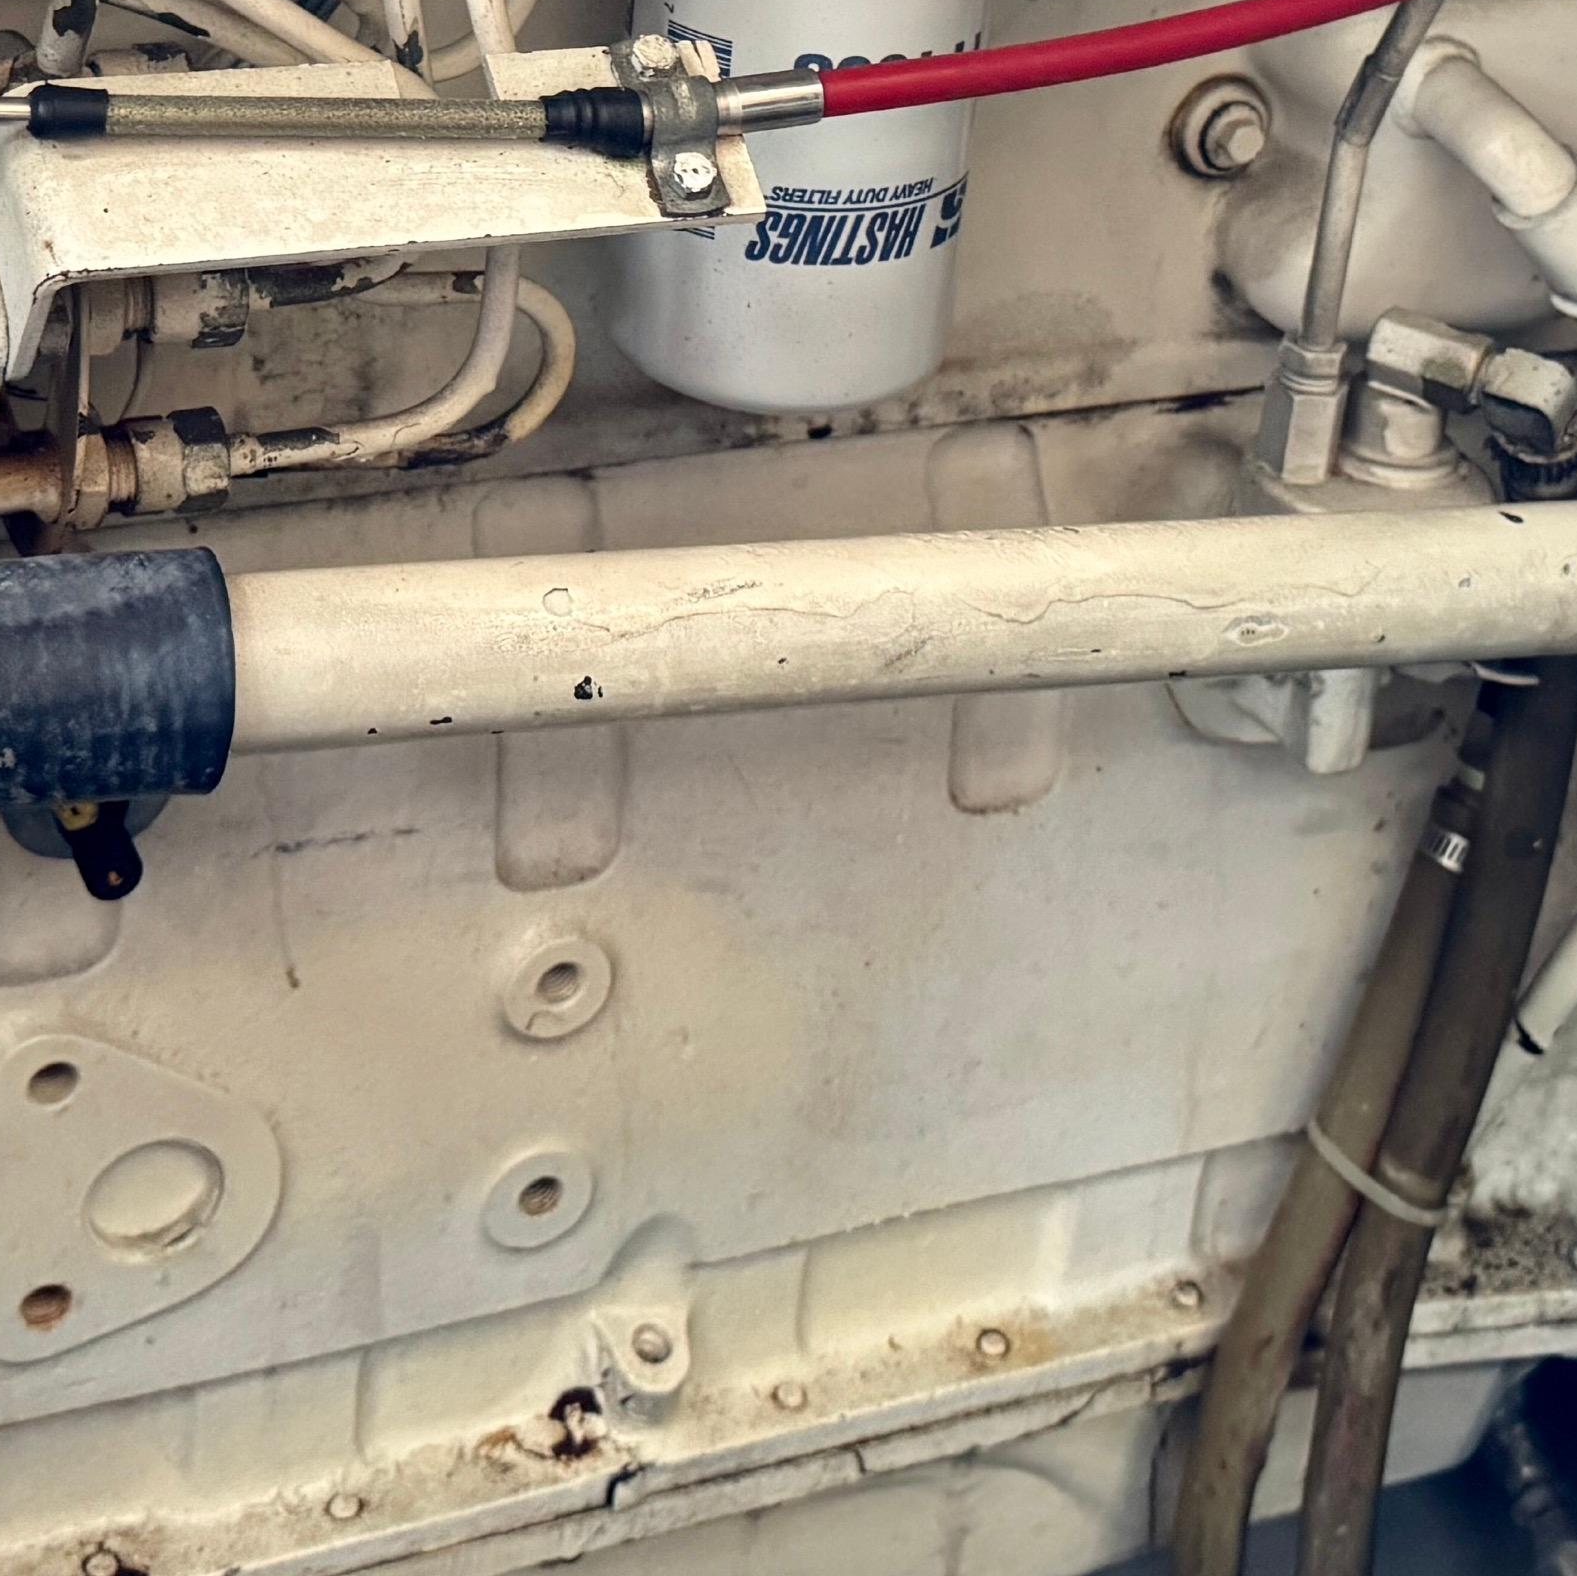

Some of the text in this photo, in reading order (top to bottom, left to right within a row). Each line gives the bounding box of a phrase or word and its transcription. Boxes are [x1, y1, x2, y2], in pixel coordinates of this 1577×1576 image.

[770, 176, 935, 205] HEAVY DUTY FILTERS
[744, 202, 927, 266] HASTINGS
